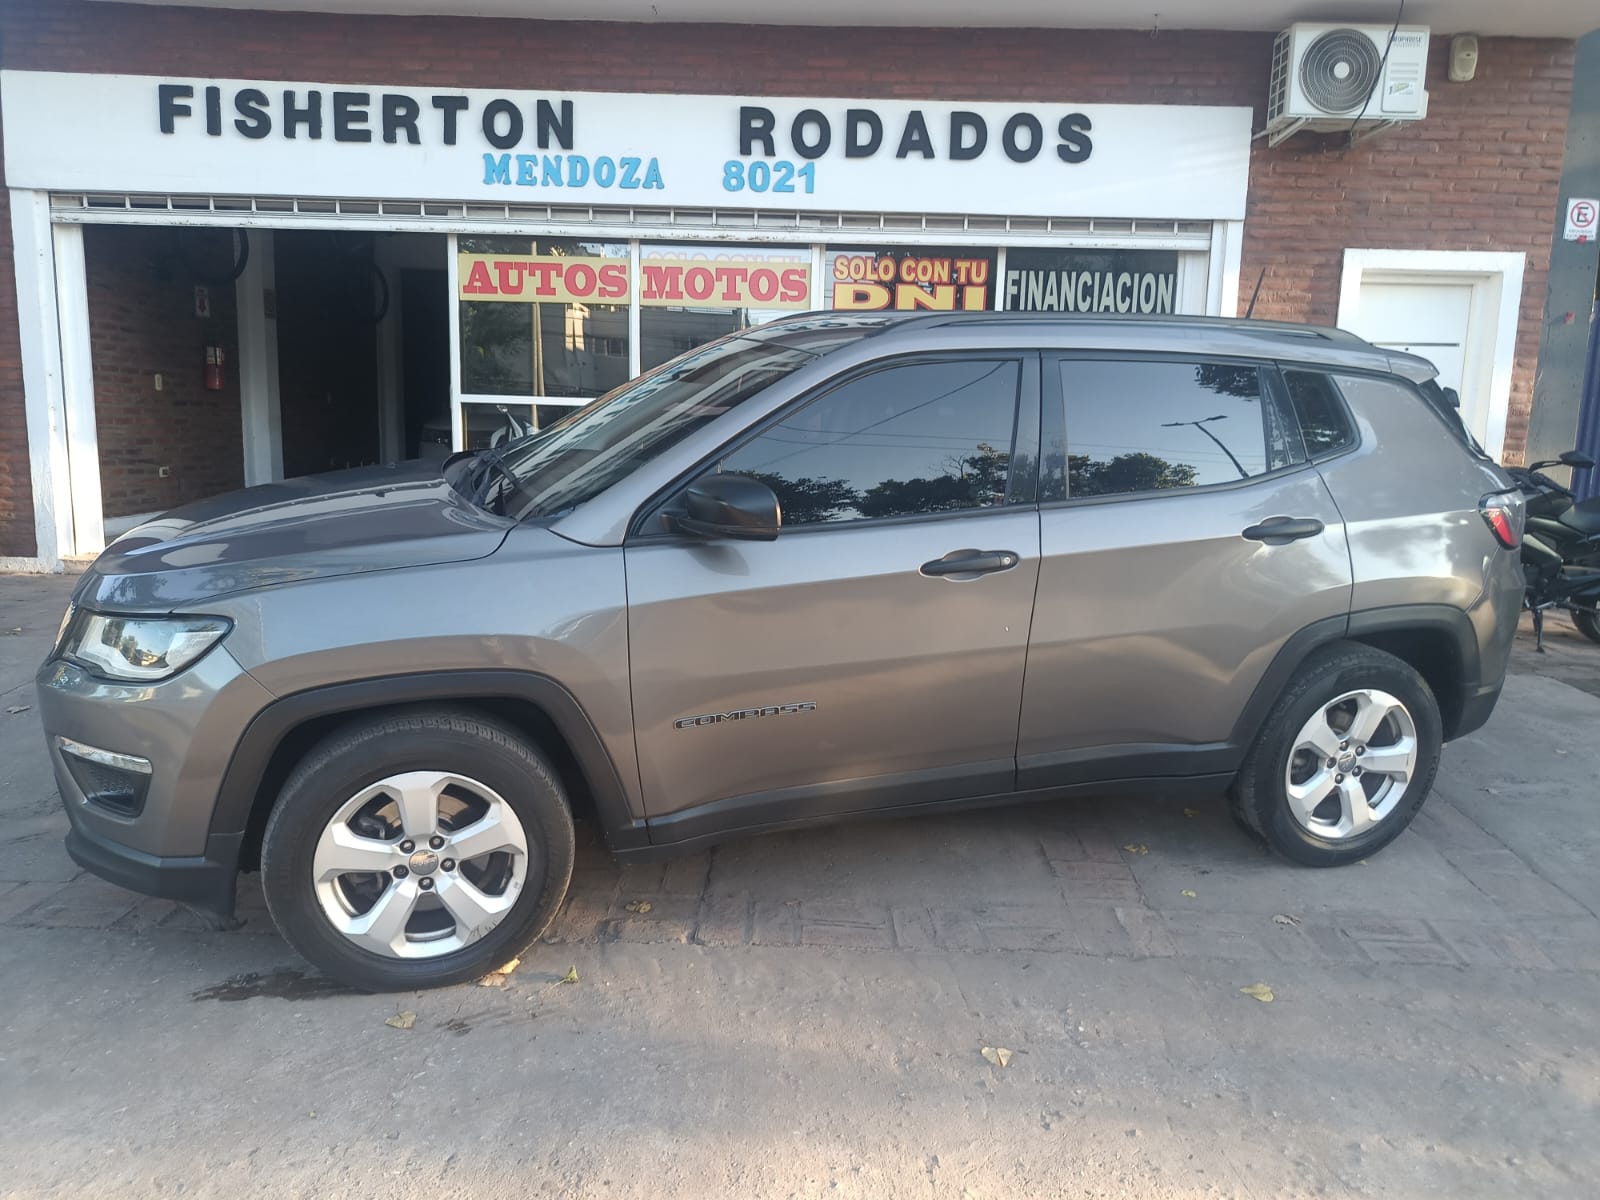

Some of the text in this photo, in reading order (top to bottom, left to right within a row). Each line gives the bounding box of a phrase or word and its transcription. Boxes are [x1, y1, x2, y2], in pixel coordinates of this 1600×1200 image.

[157, 84, 1093, 164] FISHERTON RODADOS
[482, 153, 816, 194] MENDOZA 8021
[463, 260, 628, 298] AUTOS
[642, 265, 808, 303] MOTOS
[833, 254, 897, 282] SOLO
[899, 255, 952, 284] CON
[953, 257, 989, 286] TU
[832, 281, 988, 311] DNI
[1005, 269, 1174, 314] FINANCIACION
[673, 701, 817, 730] COMPASS
